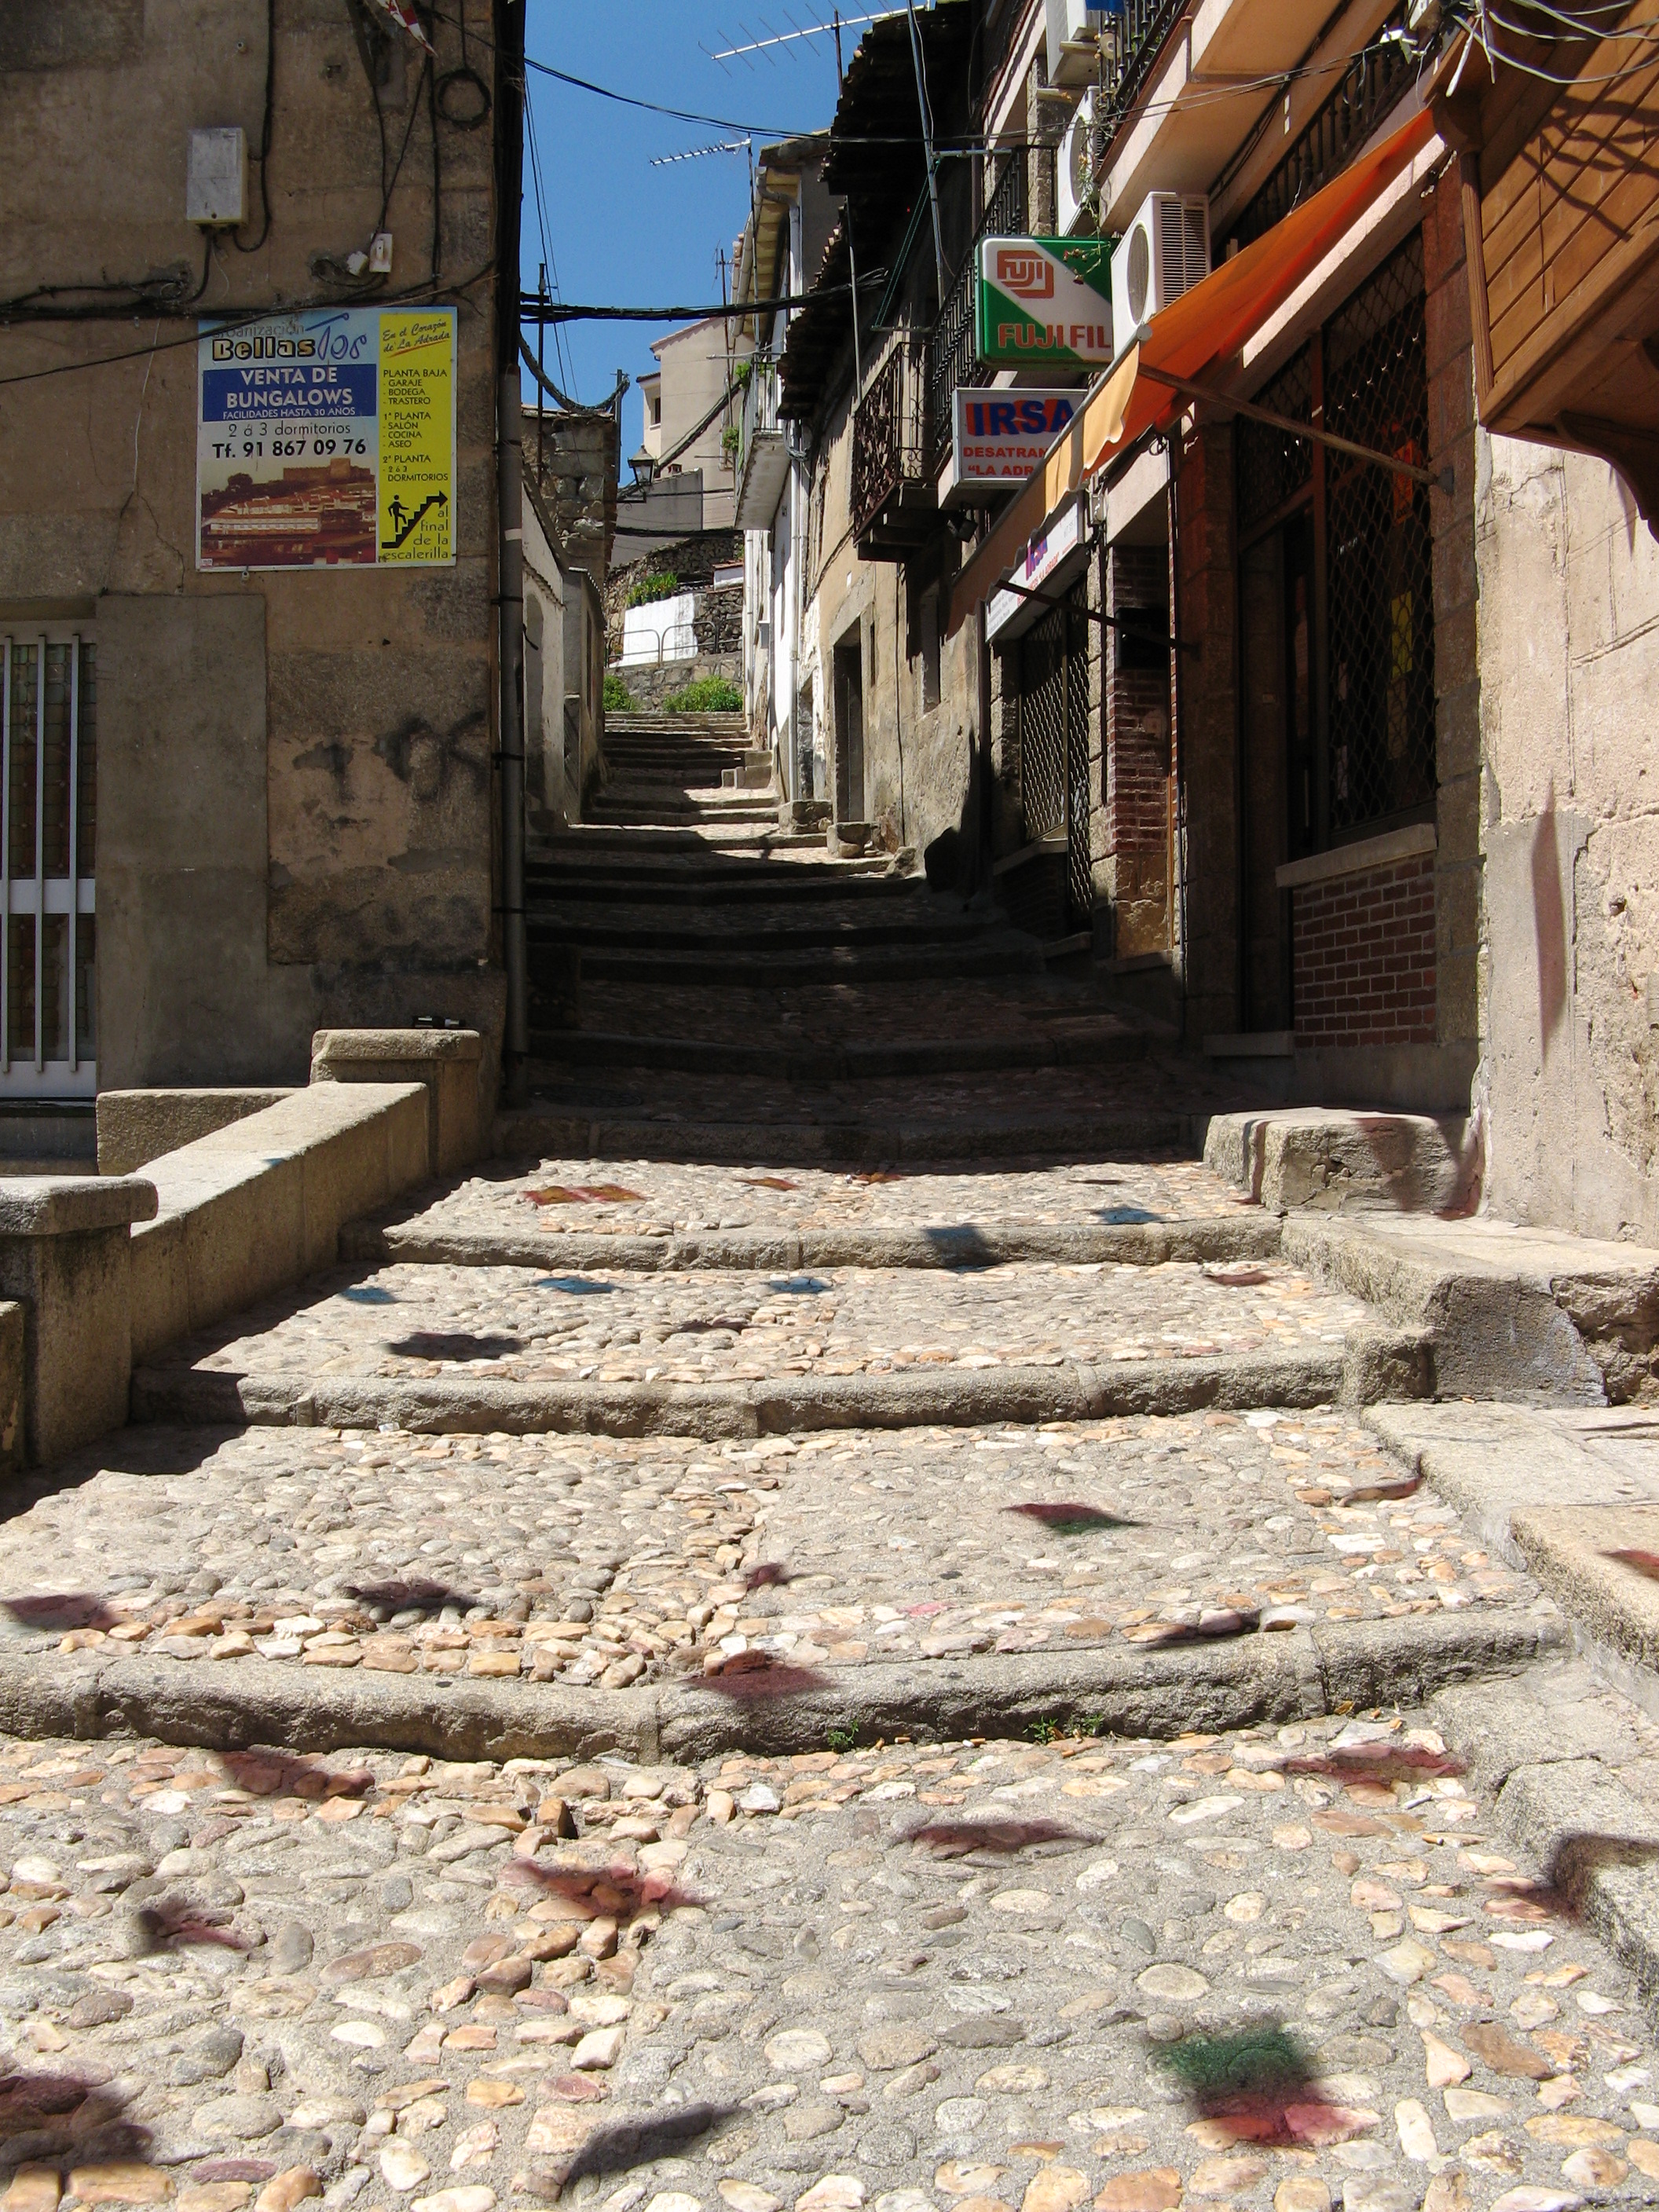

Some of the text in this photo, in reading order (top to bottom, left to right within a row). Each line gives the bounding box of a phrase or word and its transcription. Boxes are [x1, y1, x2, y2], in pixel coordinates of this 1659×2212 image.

[383, 329, 396, 341] En
[411, 318, 446, 335] Corazón
[998, 324, 1112, 348] FUJIFIL
[212, 336, 316, 361] Bellas
[383, 343, 394, 353] de
[414, 331, 450, 345] Adrada
[240, 366, 338, 386] VENTA DE
[423, 368, 448, 377] BAJA
[226, 388, 353, 408] BUNGALOWS
[223, 405, 356, 420] FACILIDADES HASTA 30 AÑOS
[965, 399, 1075, 437] IRSA
[229, 423, 236, 438] 2
[259, 422, 268, 436] 3
[275, 420, 350, 436] dormitorios
[388, 419, 419, 430] SALÓN
[212, 438, 366, 459] Tf. 91 867 09 76
[963, 447, 1049, 458] DESATRAN
[394, 454, 431, 463] PLANTA
[1002, 465, 1035, 475] ADR
[388, 473, 449, 482] DORMITORIOS
[438, 505, 448, 518] al
[421, 518, 448, 532] final
[413, 533, 448, 545] de la
[383, 546, 448, 559] escalerilla
